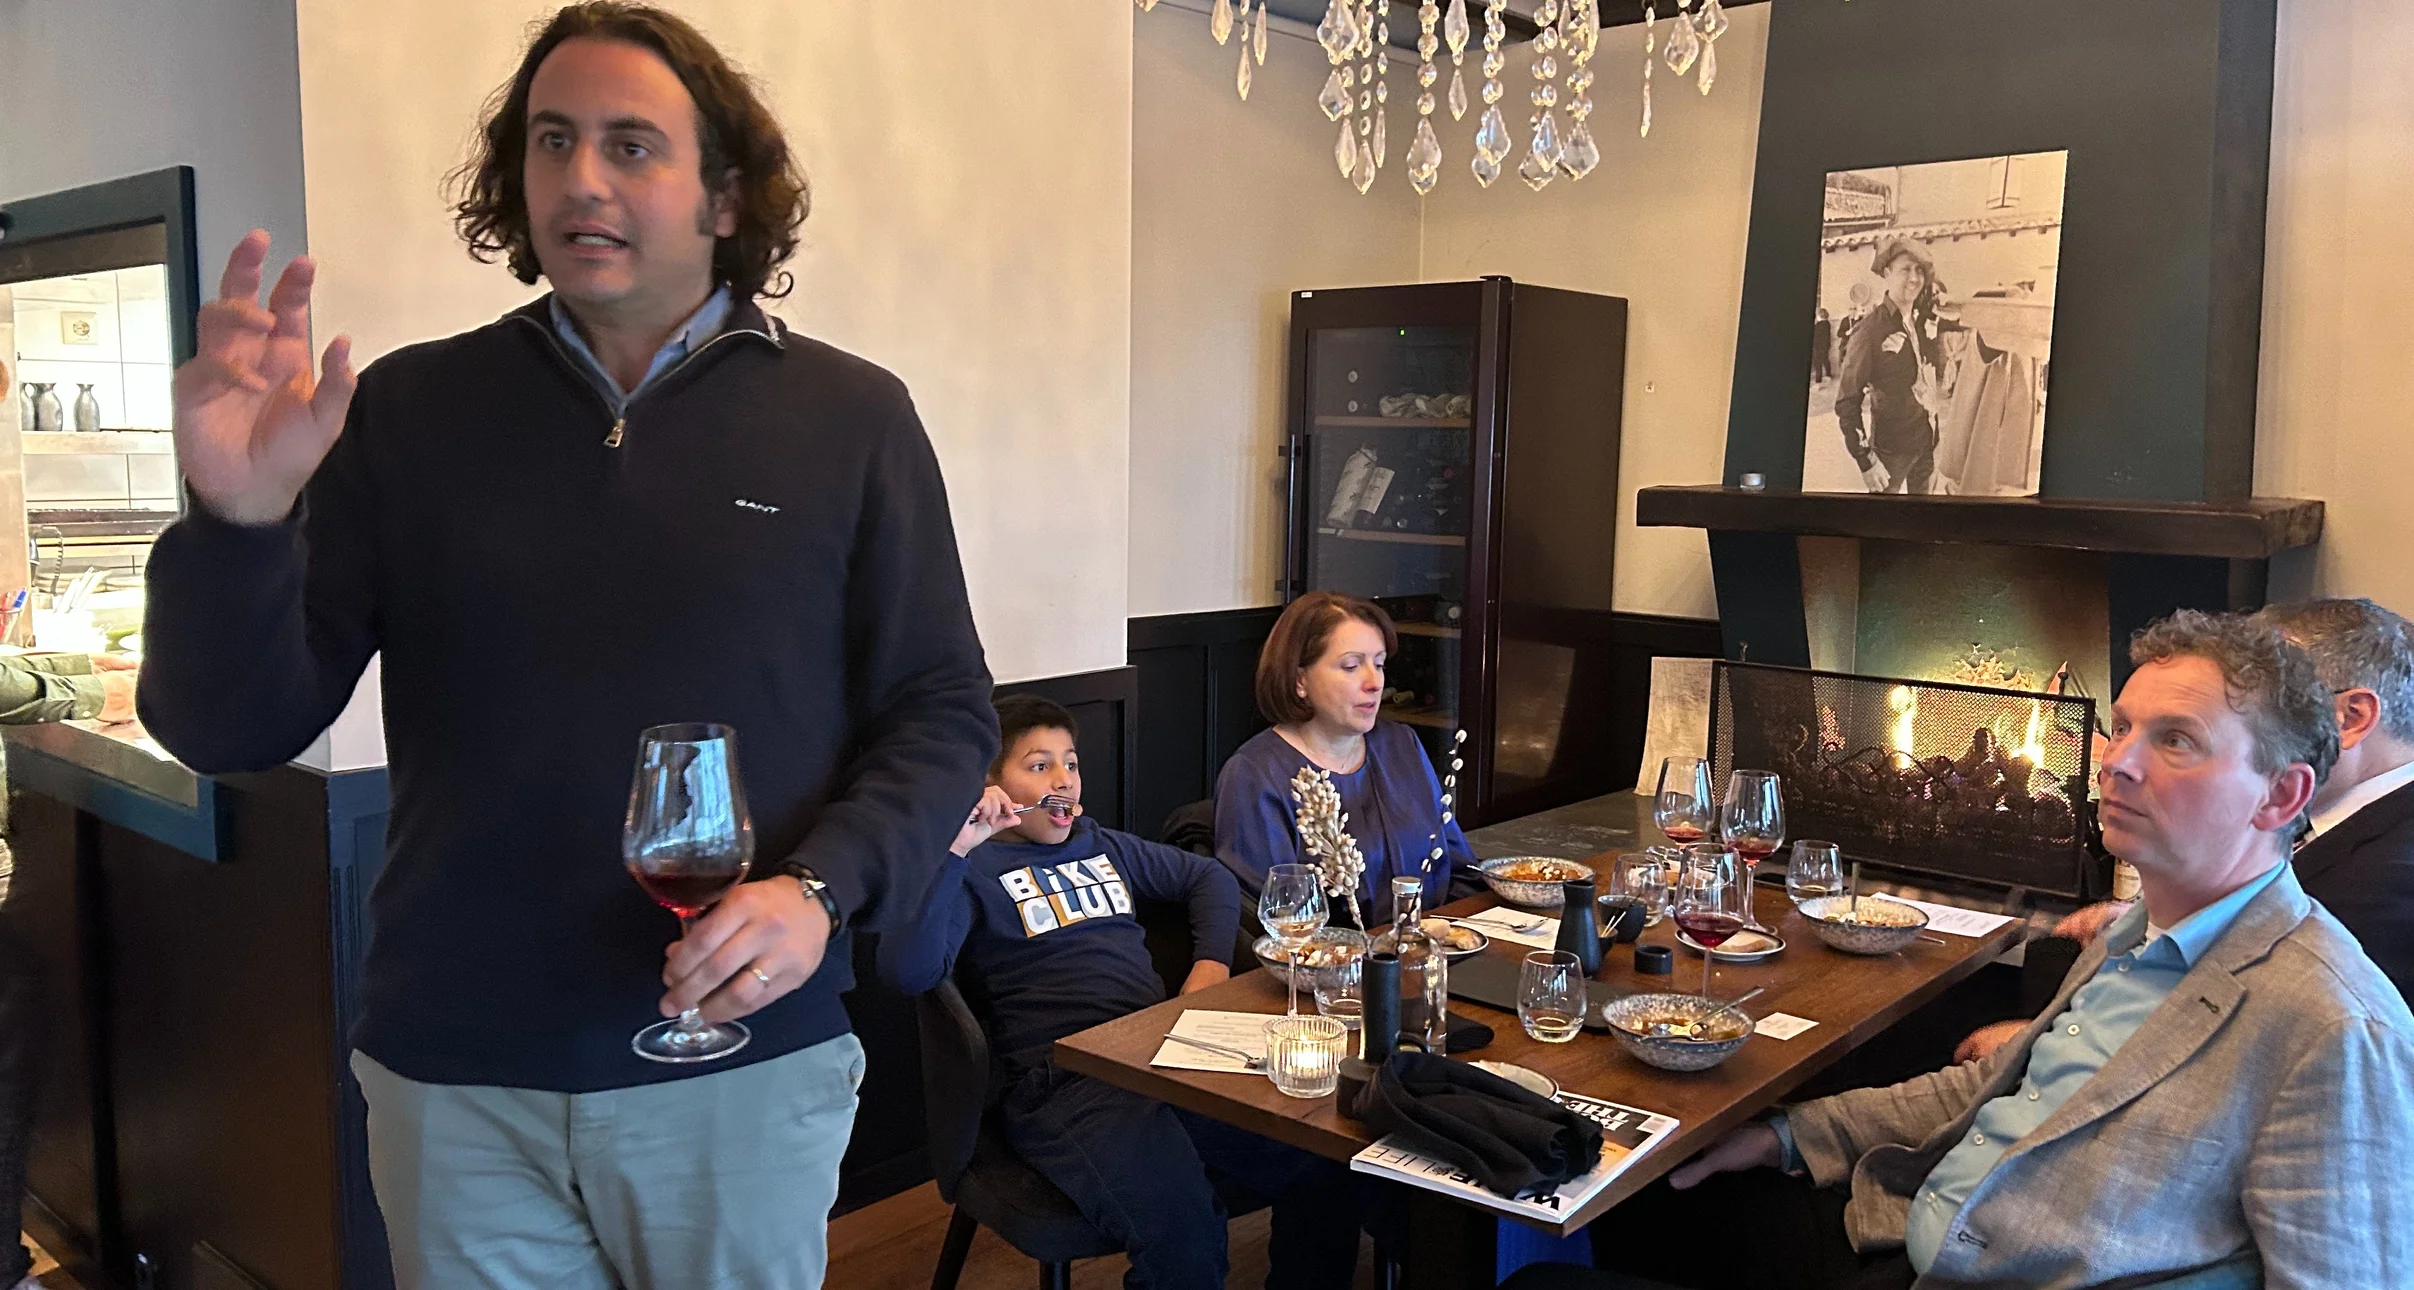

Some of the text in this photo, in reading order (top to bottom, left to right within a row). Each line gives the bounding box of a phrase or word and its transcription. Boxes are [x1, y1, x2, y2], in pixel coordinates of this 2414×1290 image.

[1021, 882, 1132, 935] CLUB
[1565, 1100, 1630, 1124] THE
[1363, 1146, 1437, 1173] LIFE
